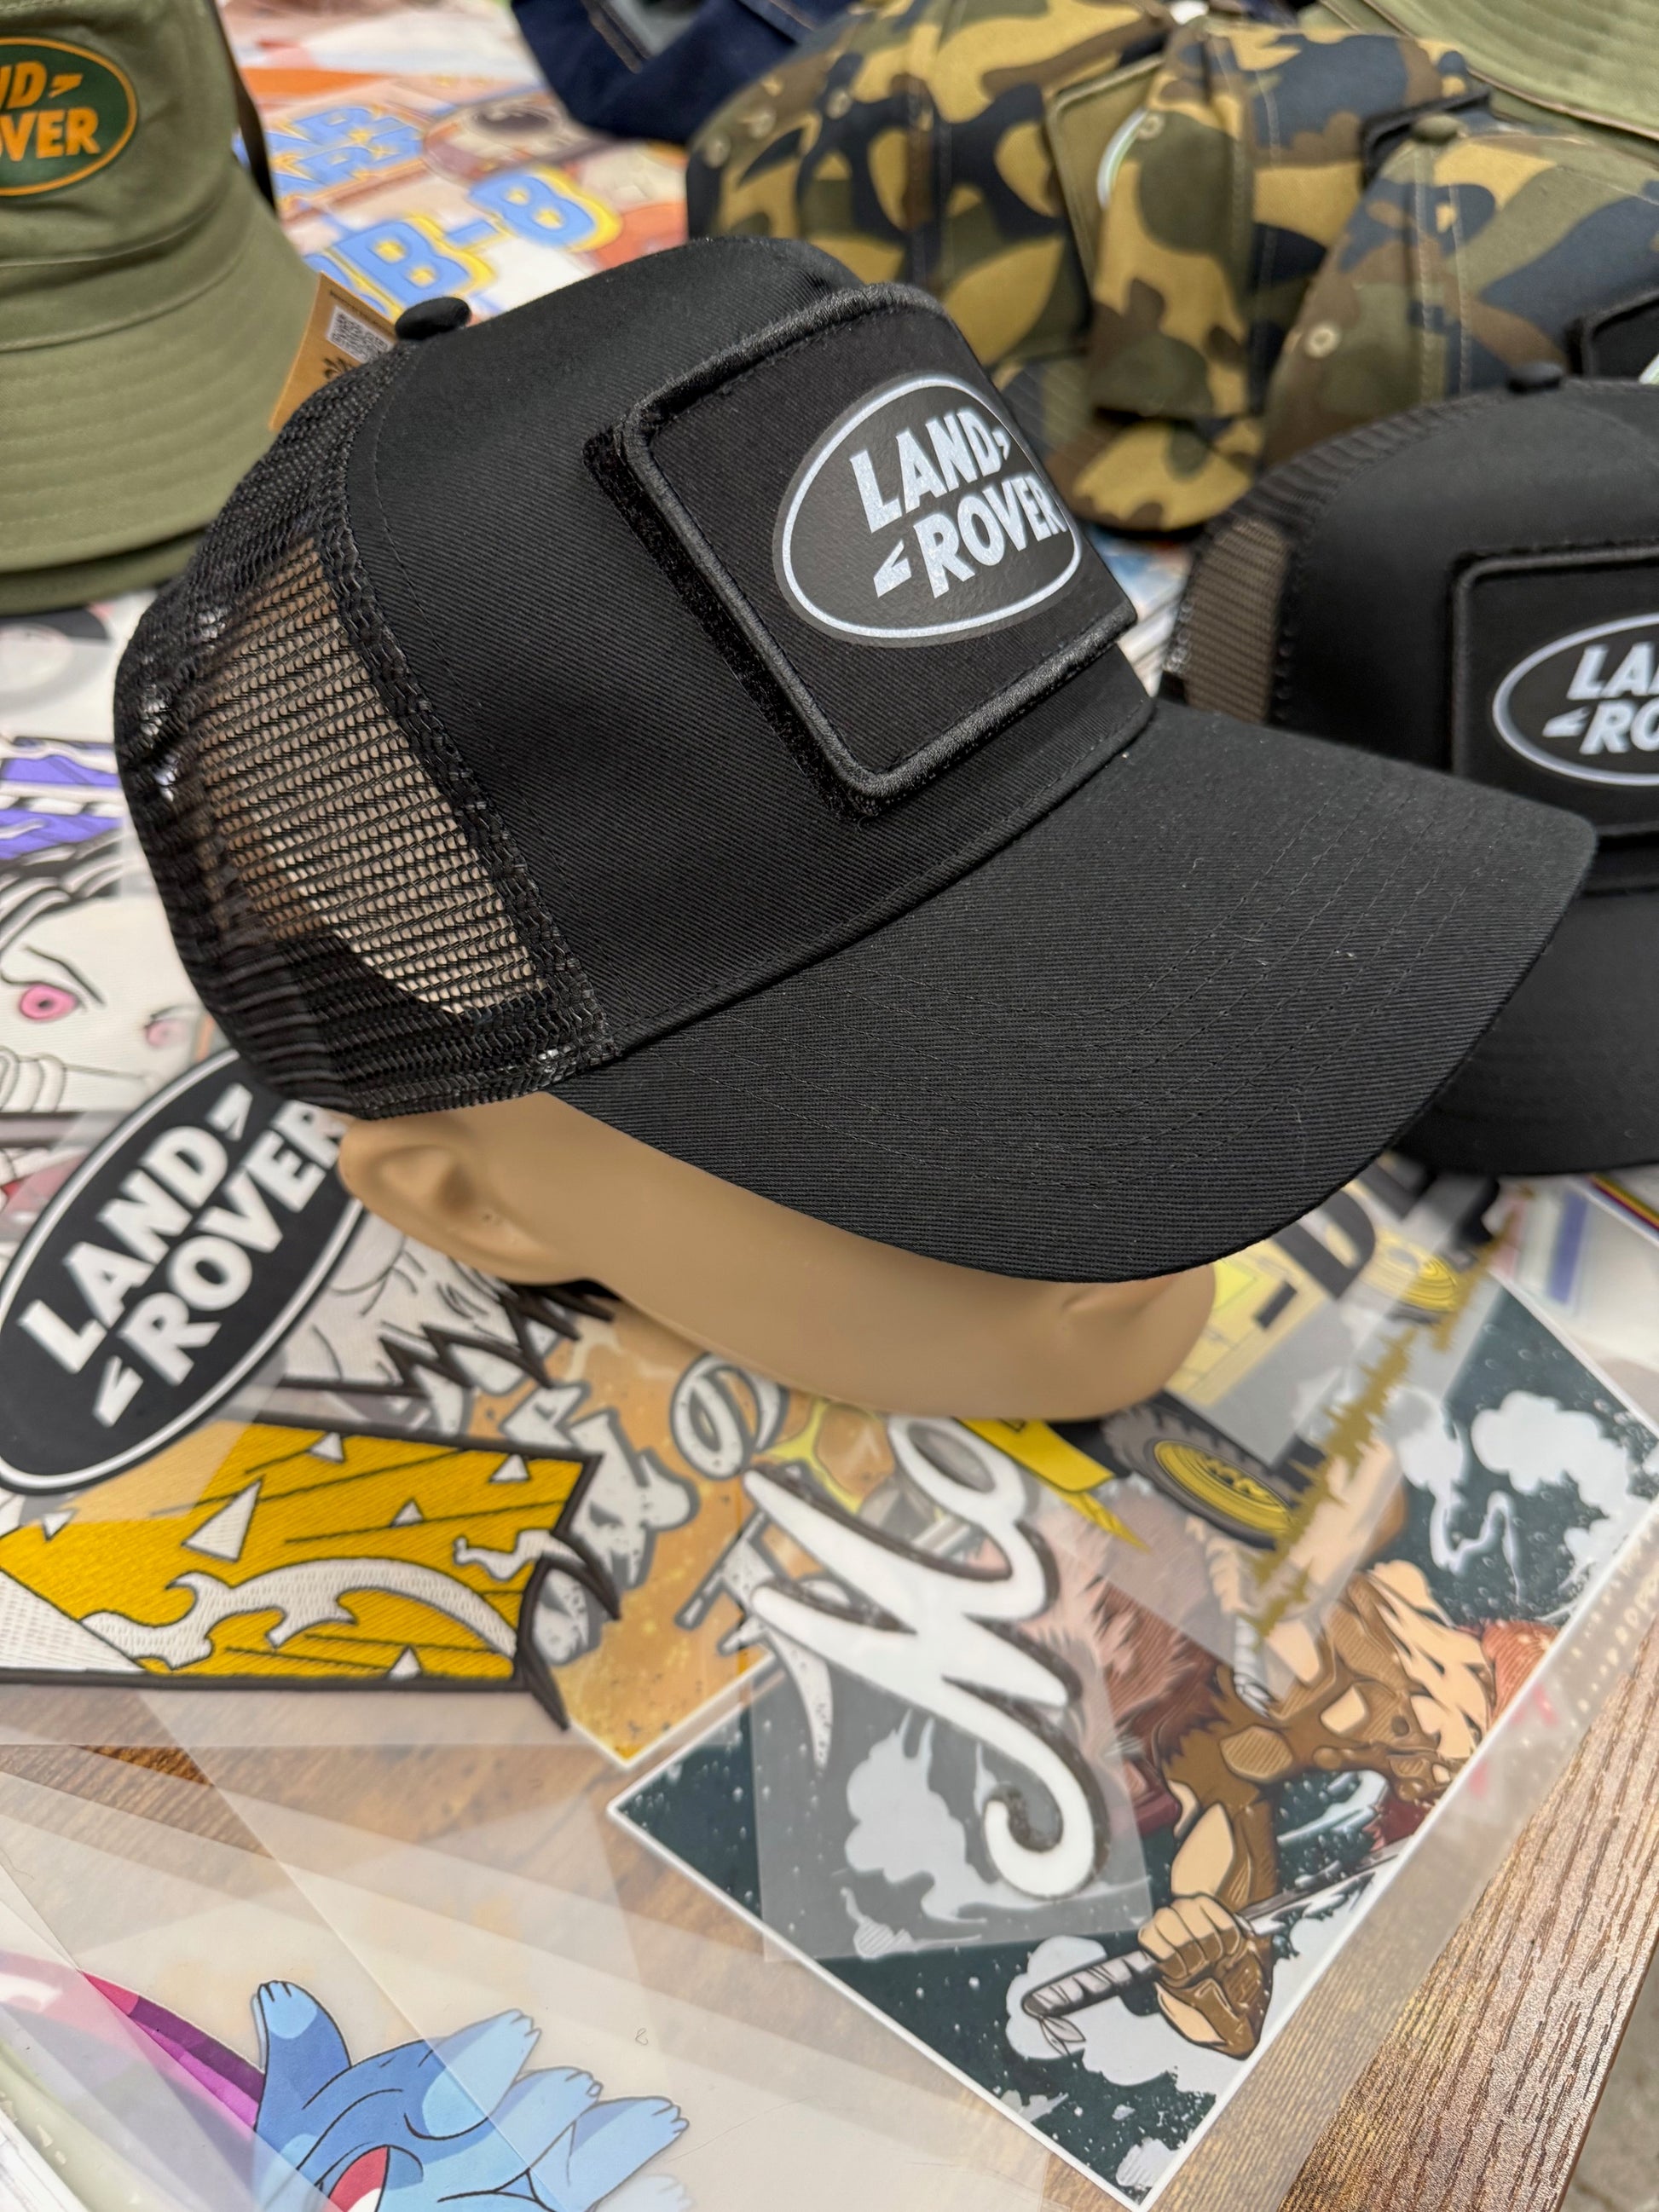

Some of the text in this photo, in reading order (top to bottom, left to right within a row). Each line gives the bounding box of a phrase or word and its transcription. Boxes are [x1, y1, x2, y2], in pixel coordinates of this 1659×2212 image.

[0, 106, 101, 162] VER
[850, 407, 1002, 534] LAND
[912, 473, 1067, 598] ROVER
[1566, 641, 1659, 701] LA
[16, 1125, 228, 1374] LAND
[116, 1100, 350, 1387] ROVER
